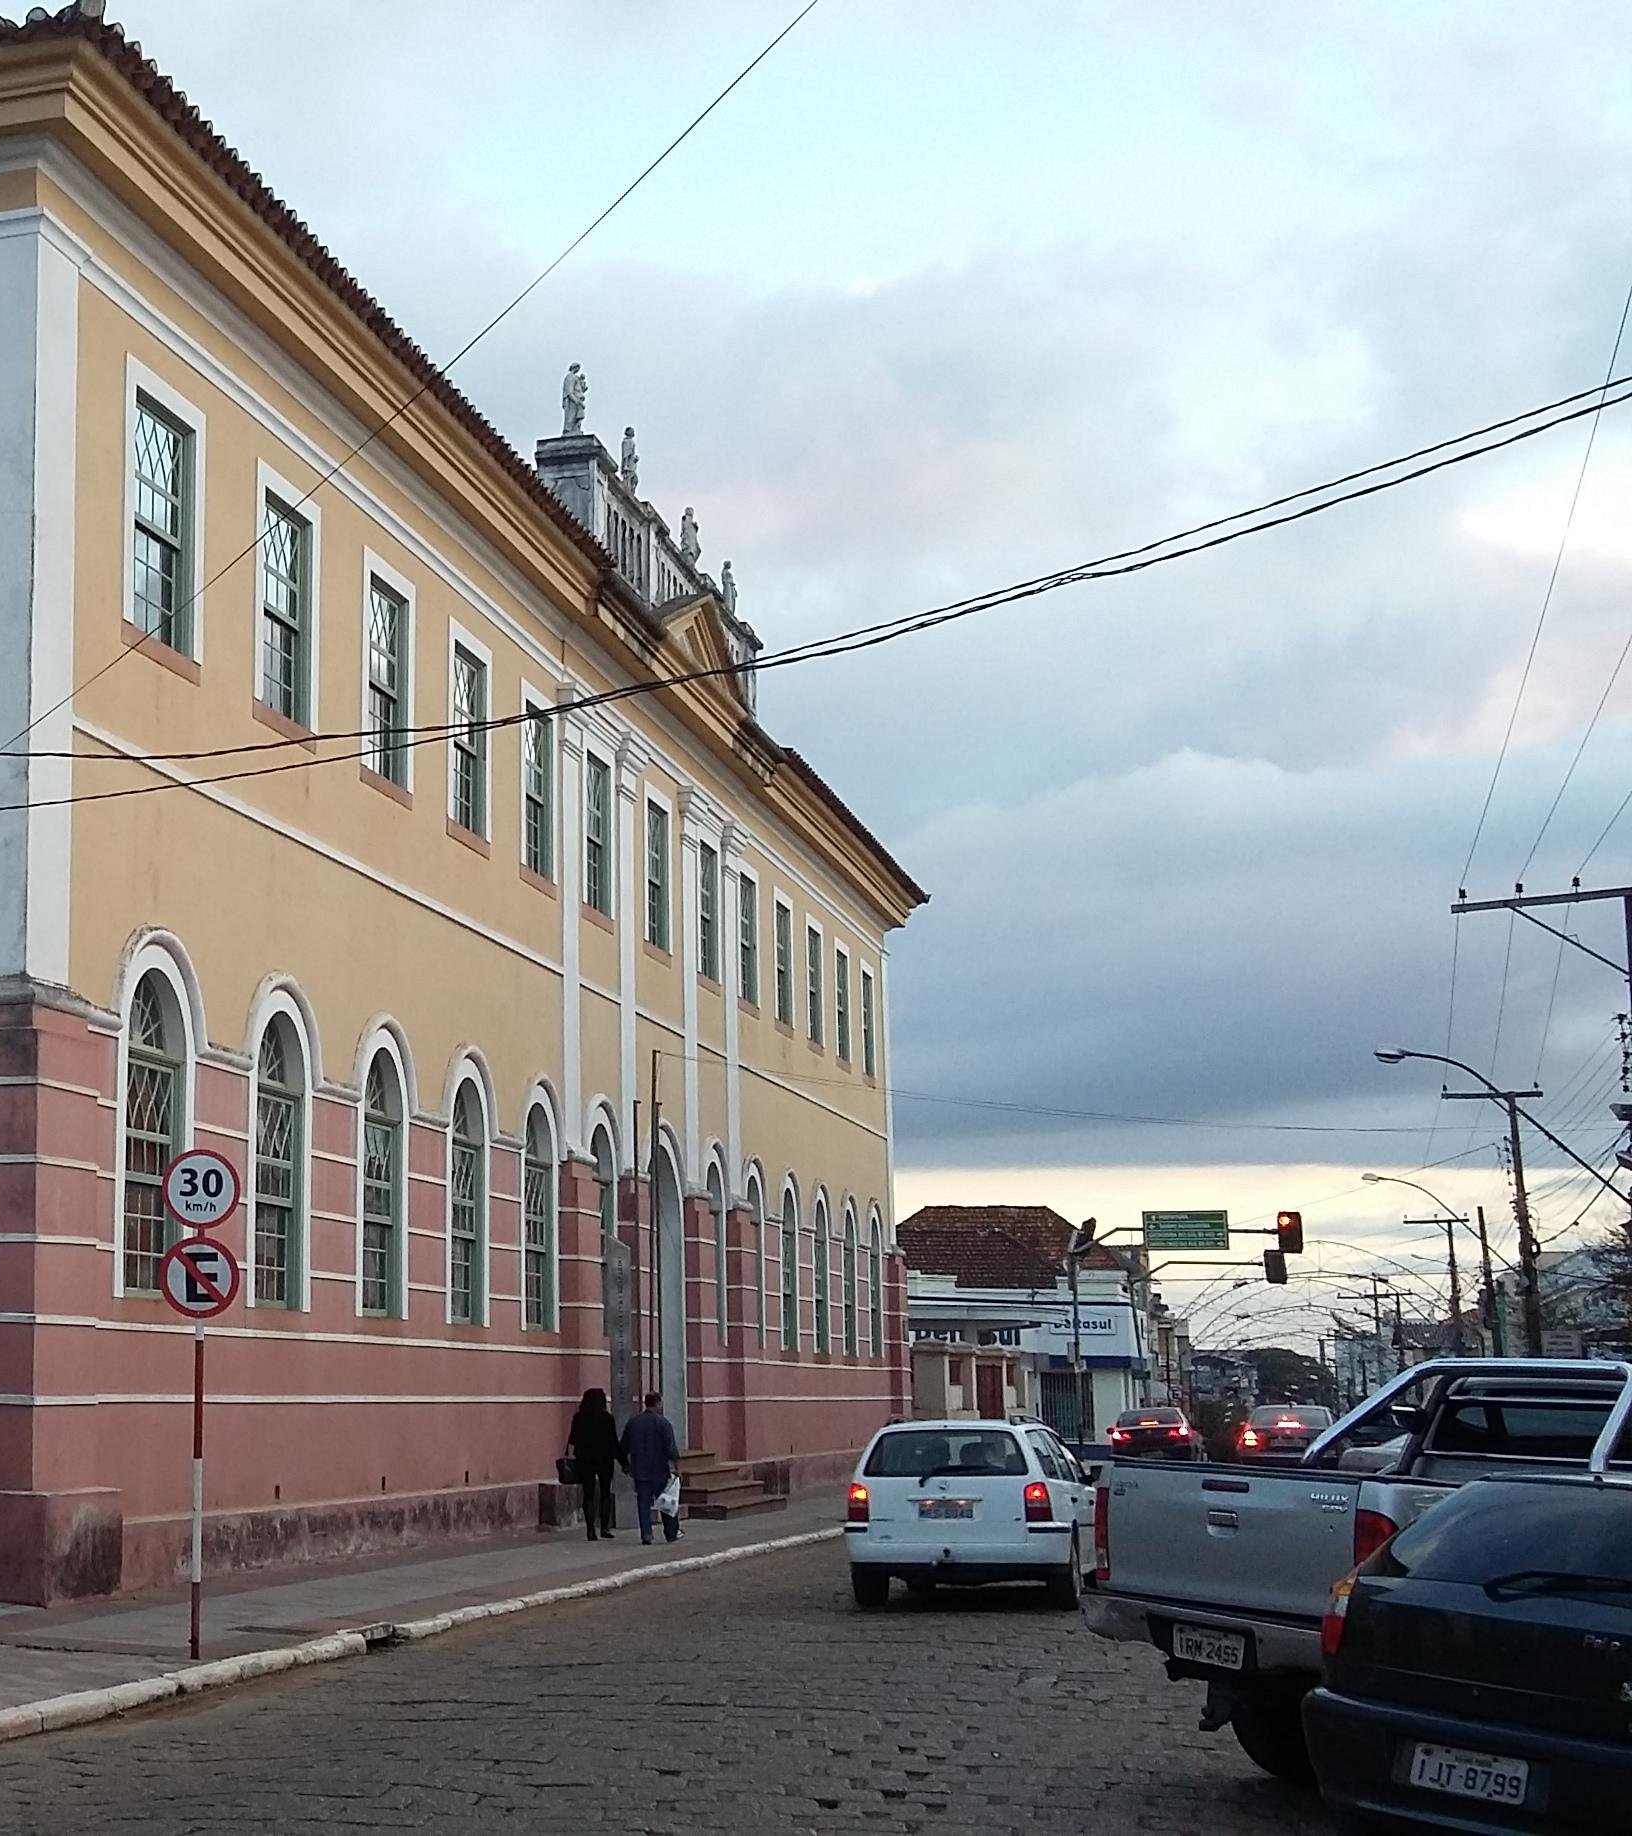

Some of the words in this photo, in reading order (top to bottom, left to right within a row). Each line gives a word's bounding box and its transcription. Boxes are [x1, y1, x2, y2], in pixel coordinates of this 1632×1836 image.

[179, 1168, 223, 1198] 30
[185, 1201, 217, 1213] km/h
[186, 1252, 218, 1302] E
